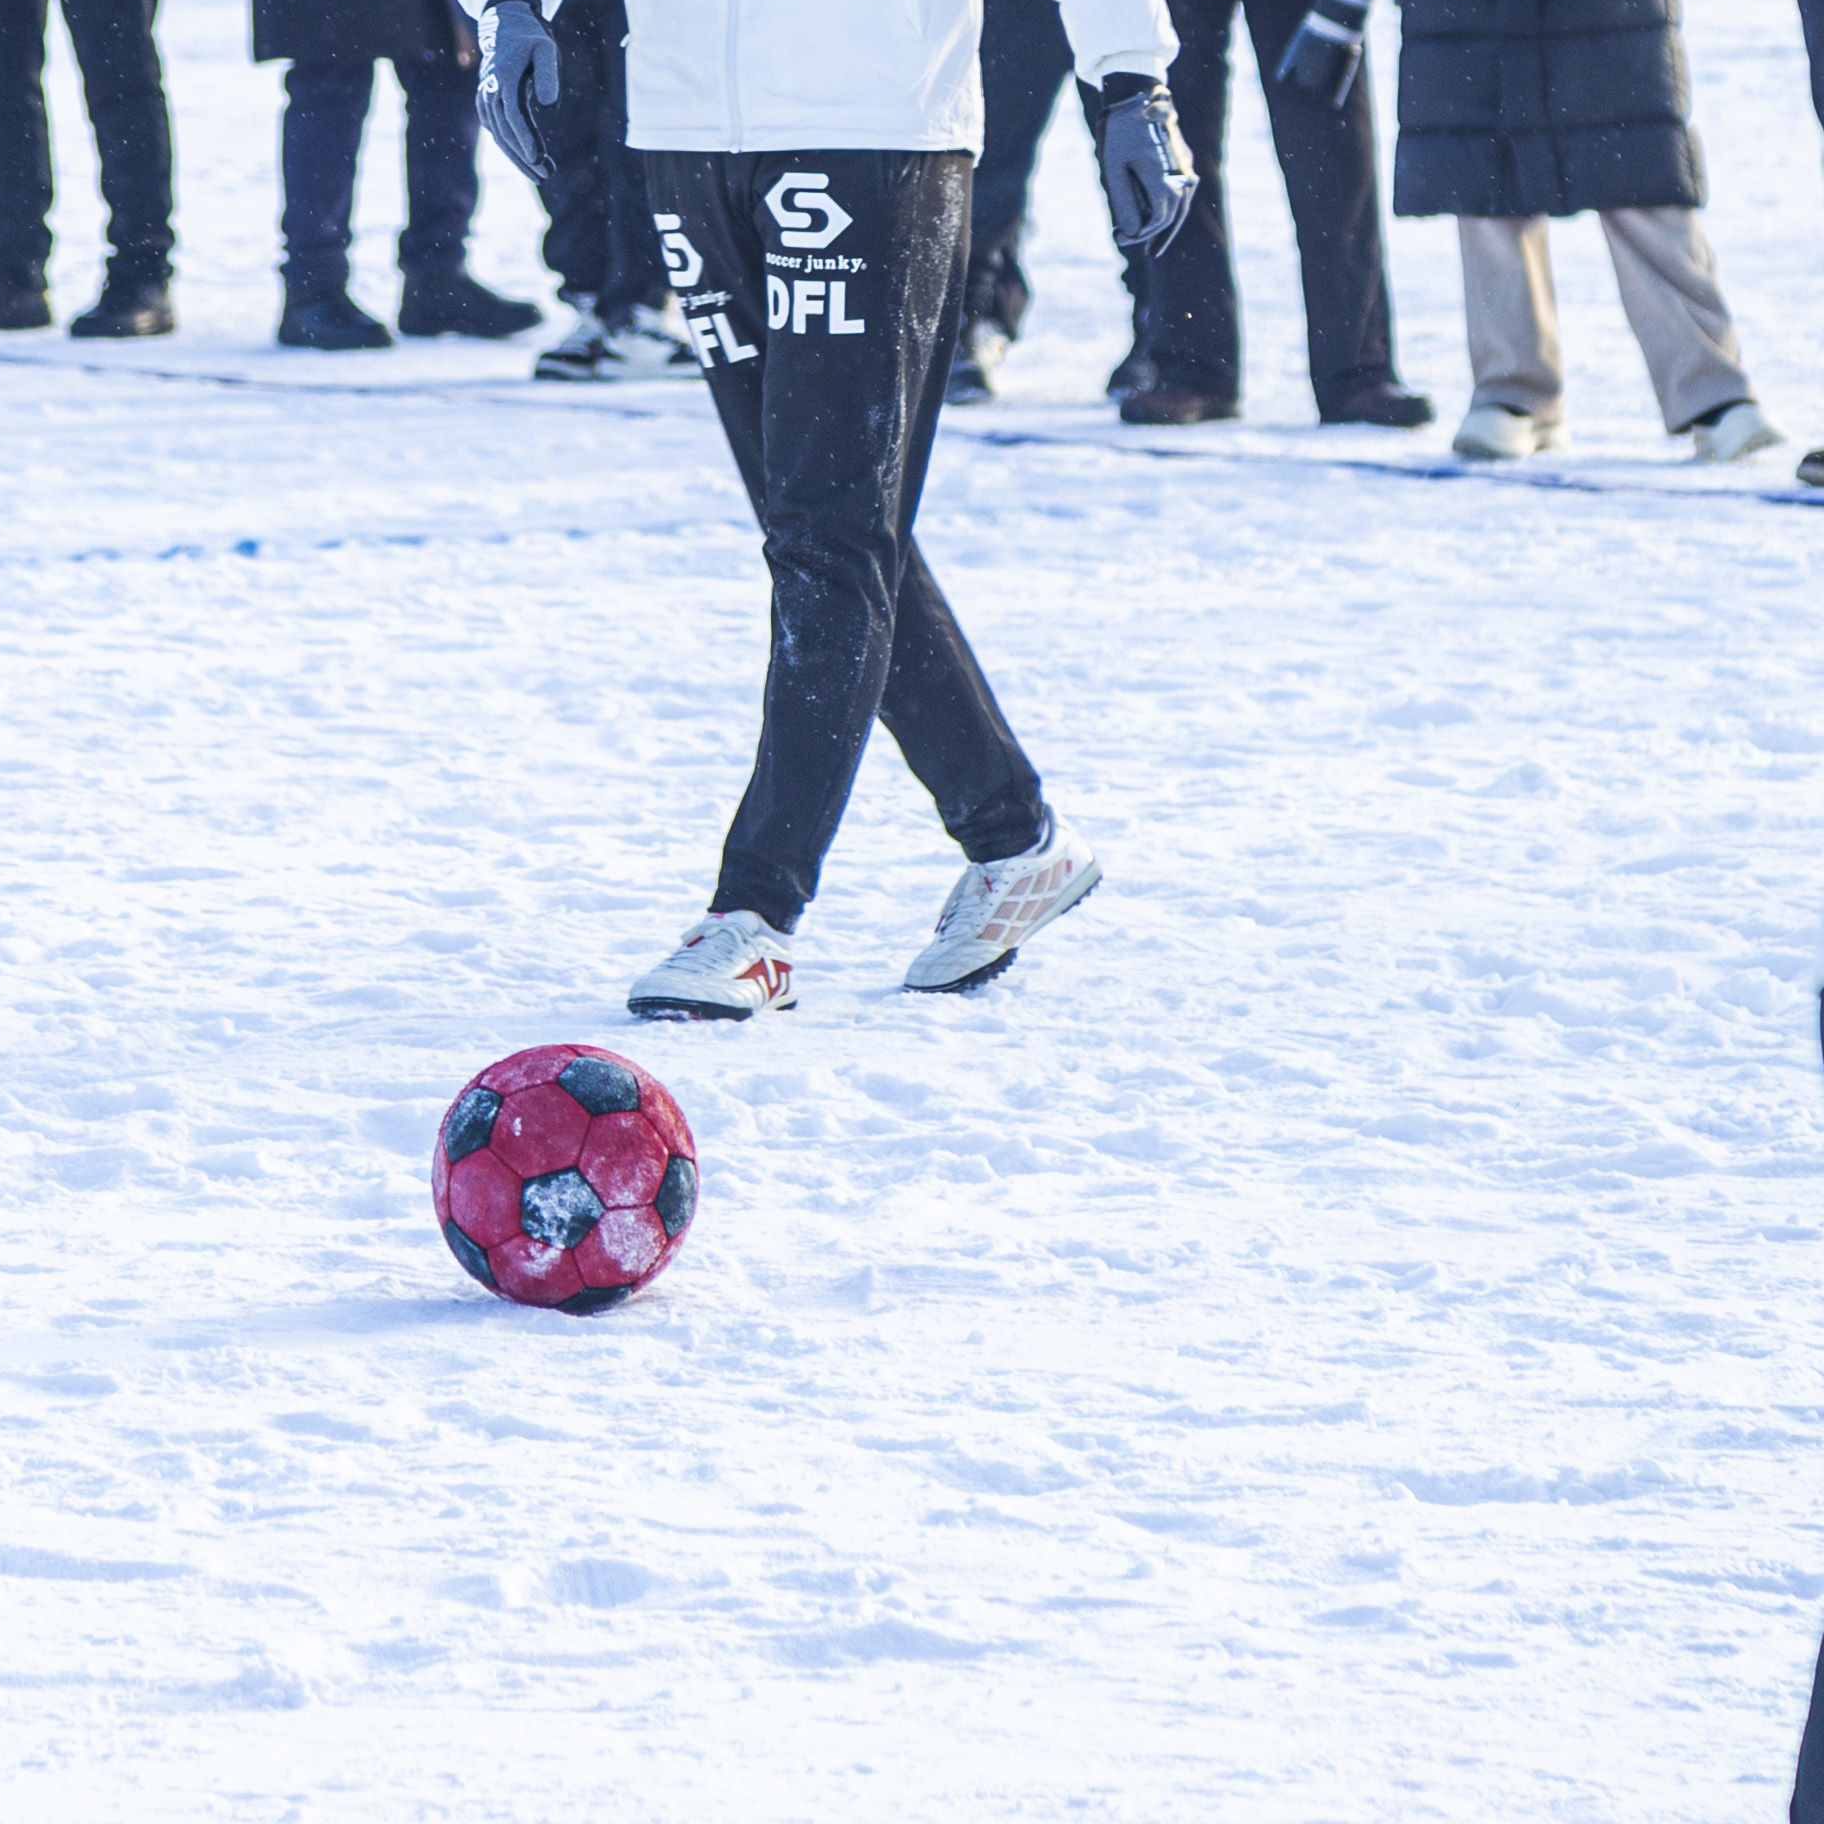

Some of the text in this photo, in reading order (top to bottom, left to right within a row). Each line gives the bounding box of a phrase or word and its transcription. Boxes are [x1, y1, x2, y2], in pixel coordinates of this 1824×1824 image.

[766, 252, 803, 269] soccer
[766, 273, 866, 335] DFL
[687, 312, 760, 369] FL
